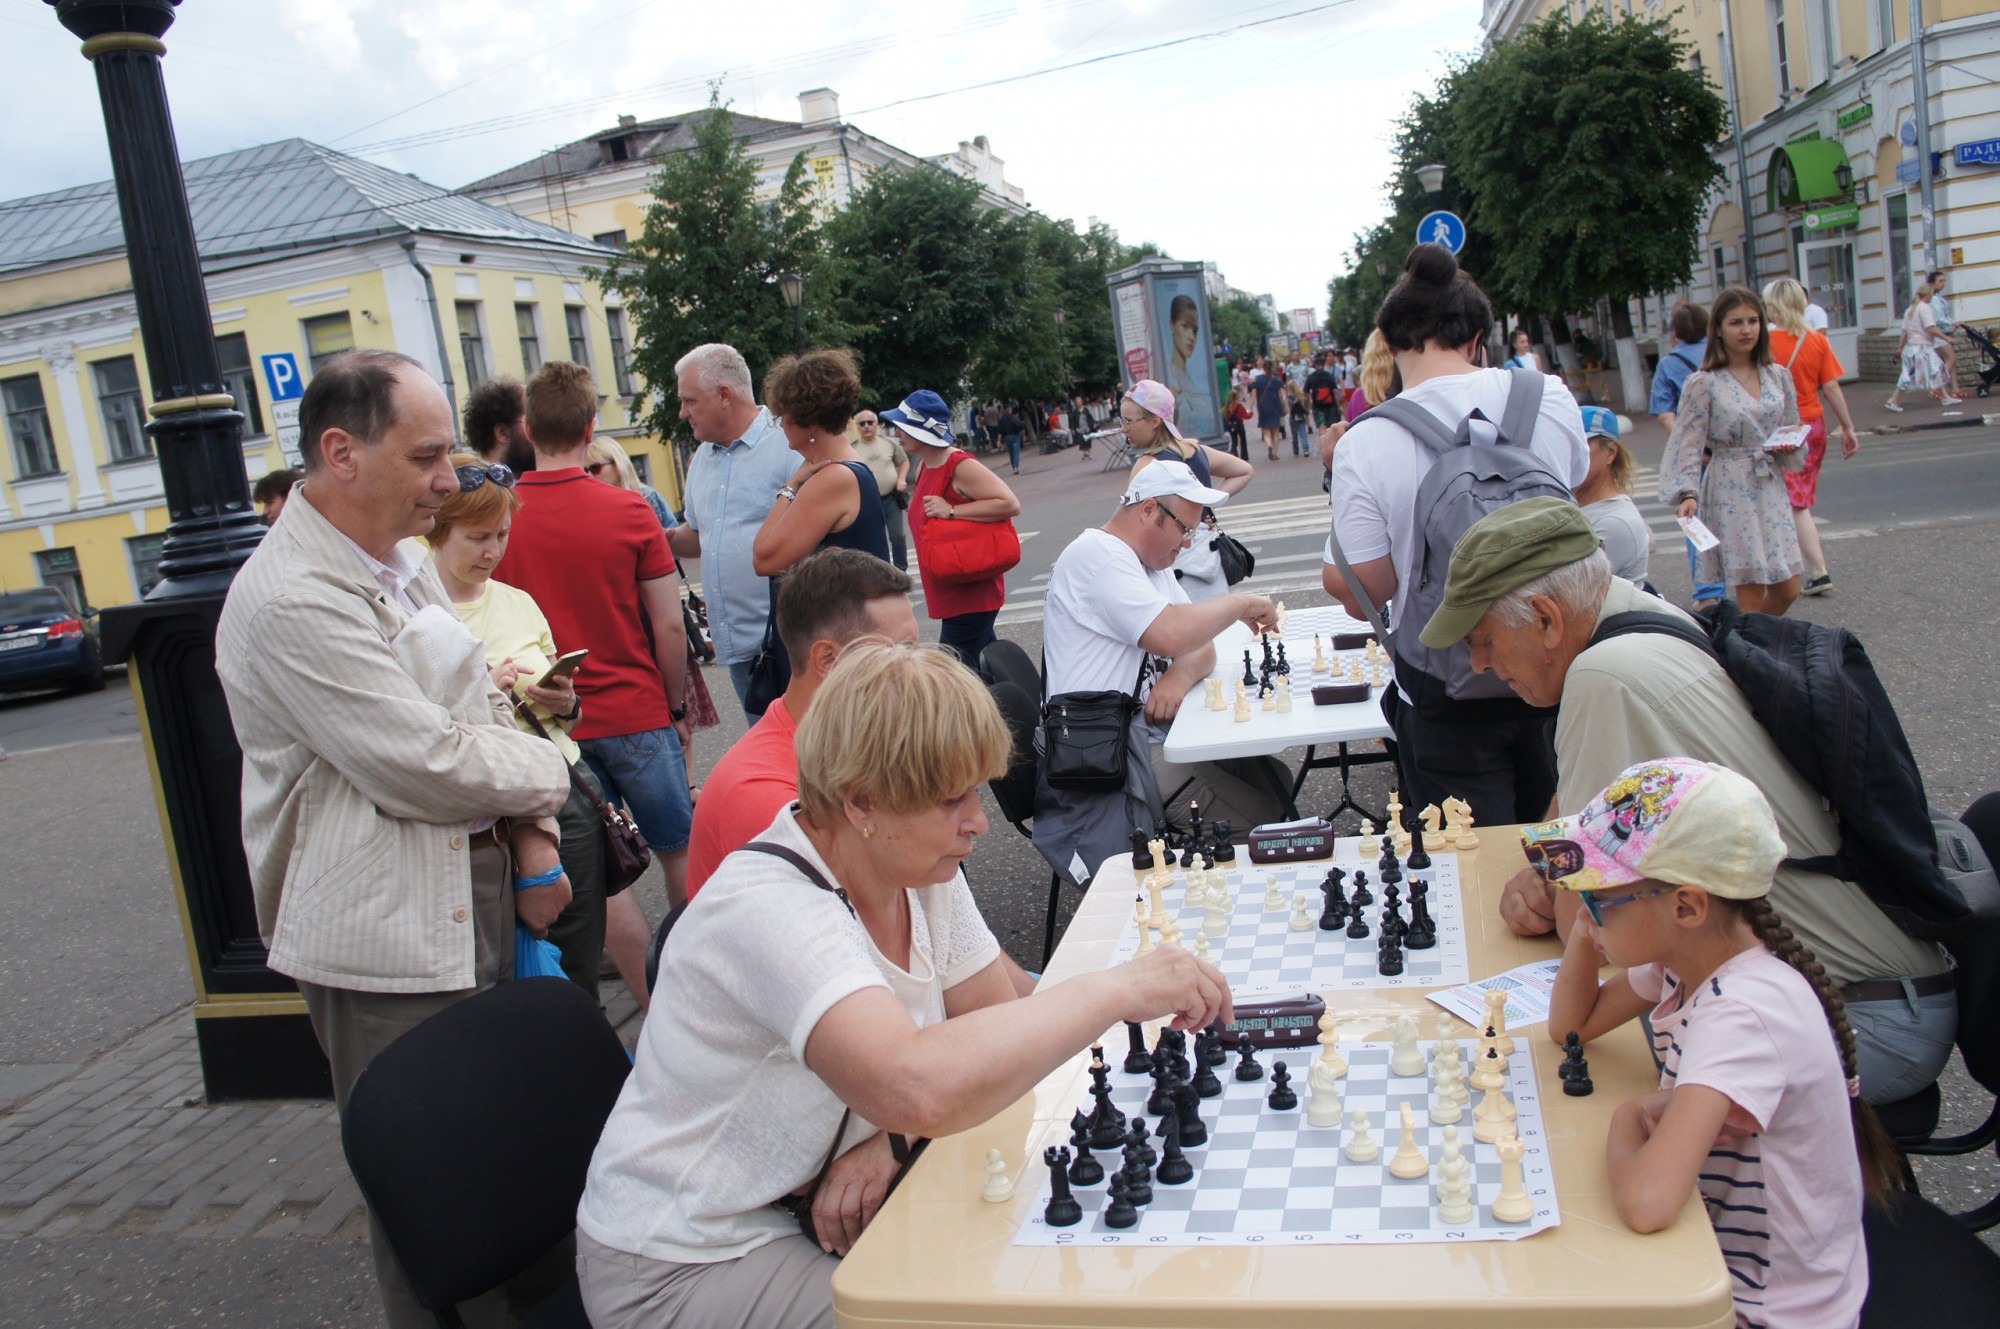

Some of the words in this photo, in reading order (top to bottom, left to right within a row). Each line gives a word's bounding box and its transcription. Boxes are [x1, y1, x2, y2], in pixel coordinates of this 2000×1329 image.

[1988, 153, 2000, 163] бу
[270, 357, 293, 396] P
[1055, 1233, 1075, 1245] 10
[1102, 1235, 1121, 1243] 9
[1149, 1235, 1168, 1243] 8
[1246, 1234, 1264, 1242] 6
[1295, 1233, 1314, 1241] 5
[1395, 1232, 1414, 1240] 3
[1446, 1231, 1465, 1239] 2
